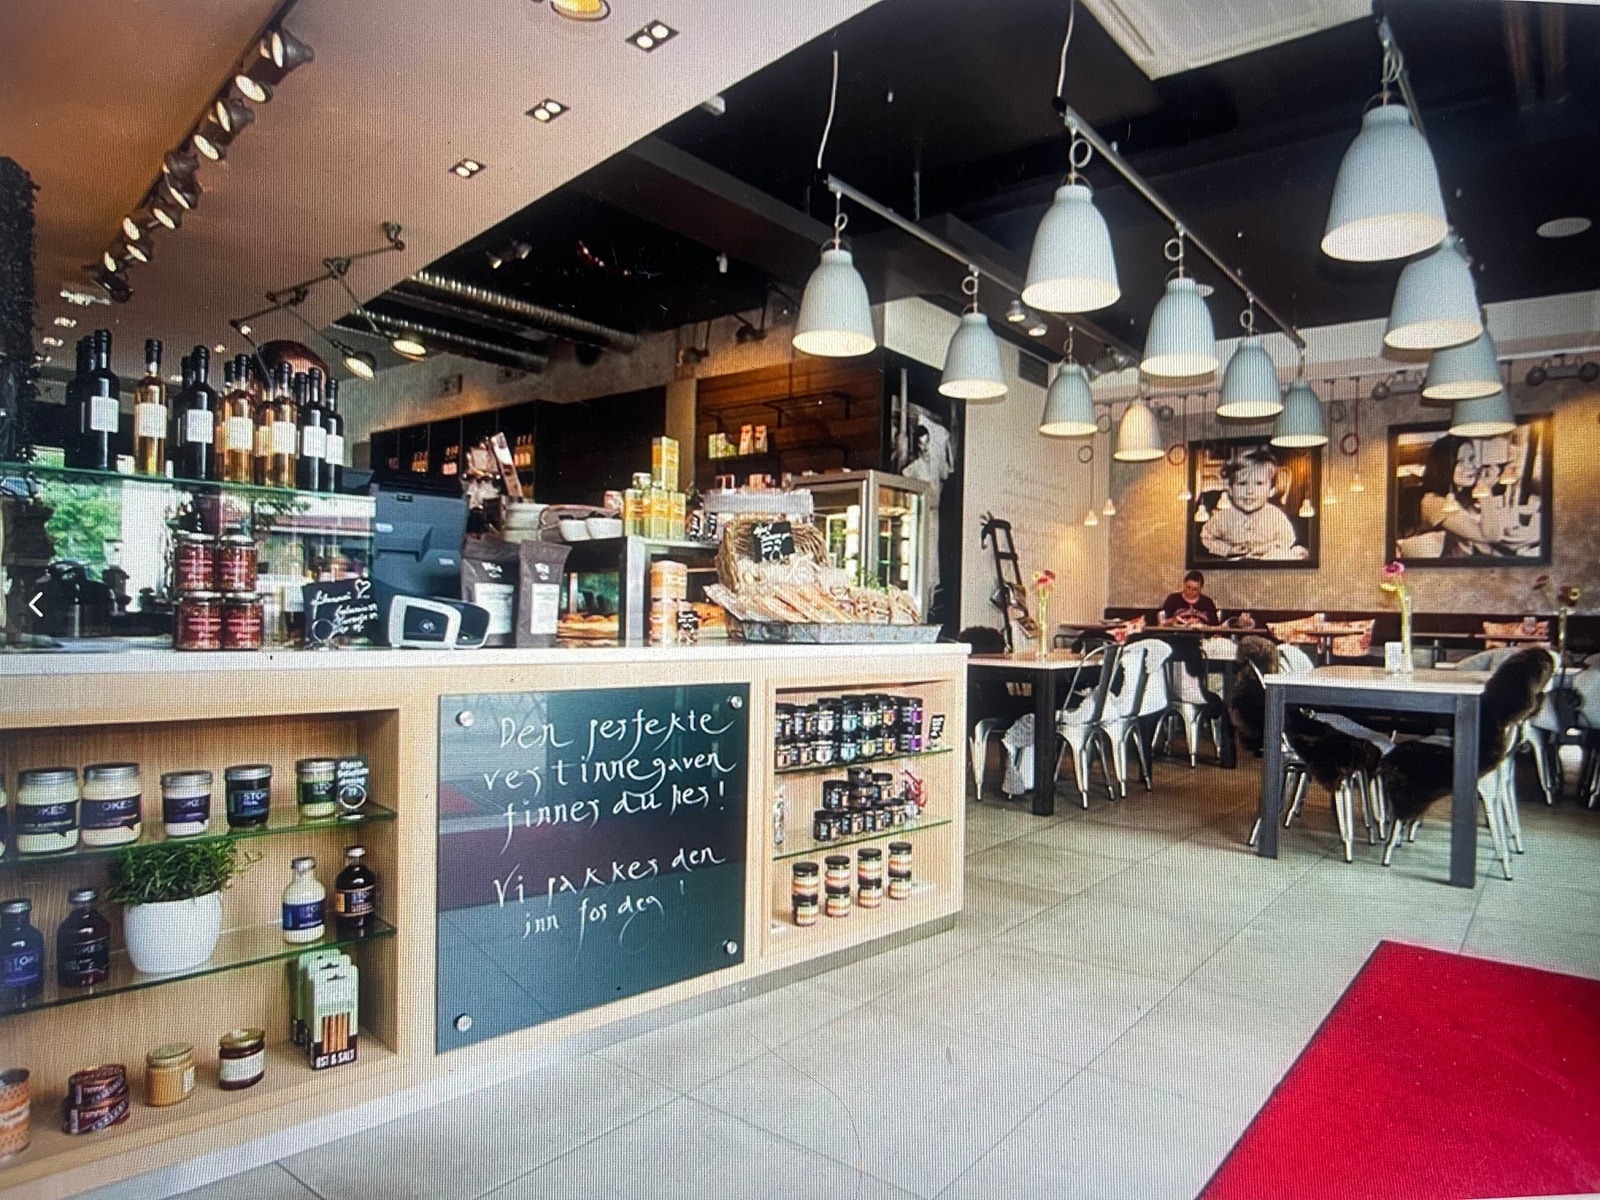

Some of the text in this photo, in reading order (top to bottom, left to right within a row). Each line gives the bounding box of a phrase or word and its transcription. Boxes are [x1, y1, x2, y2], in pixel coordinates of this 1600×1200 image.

[499, 717, 573, 748] Den
[502, 800, 600, 855] finner
[613, 791, 661, 815] du
[493, 863, 525, 908] Vi
[672, 845, 726, 873] den
[575, 898, 608, 959] for
